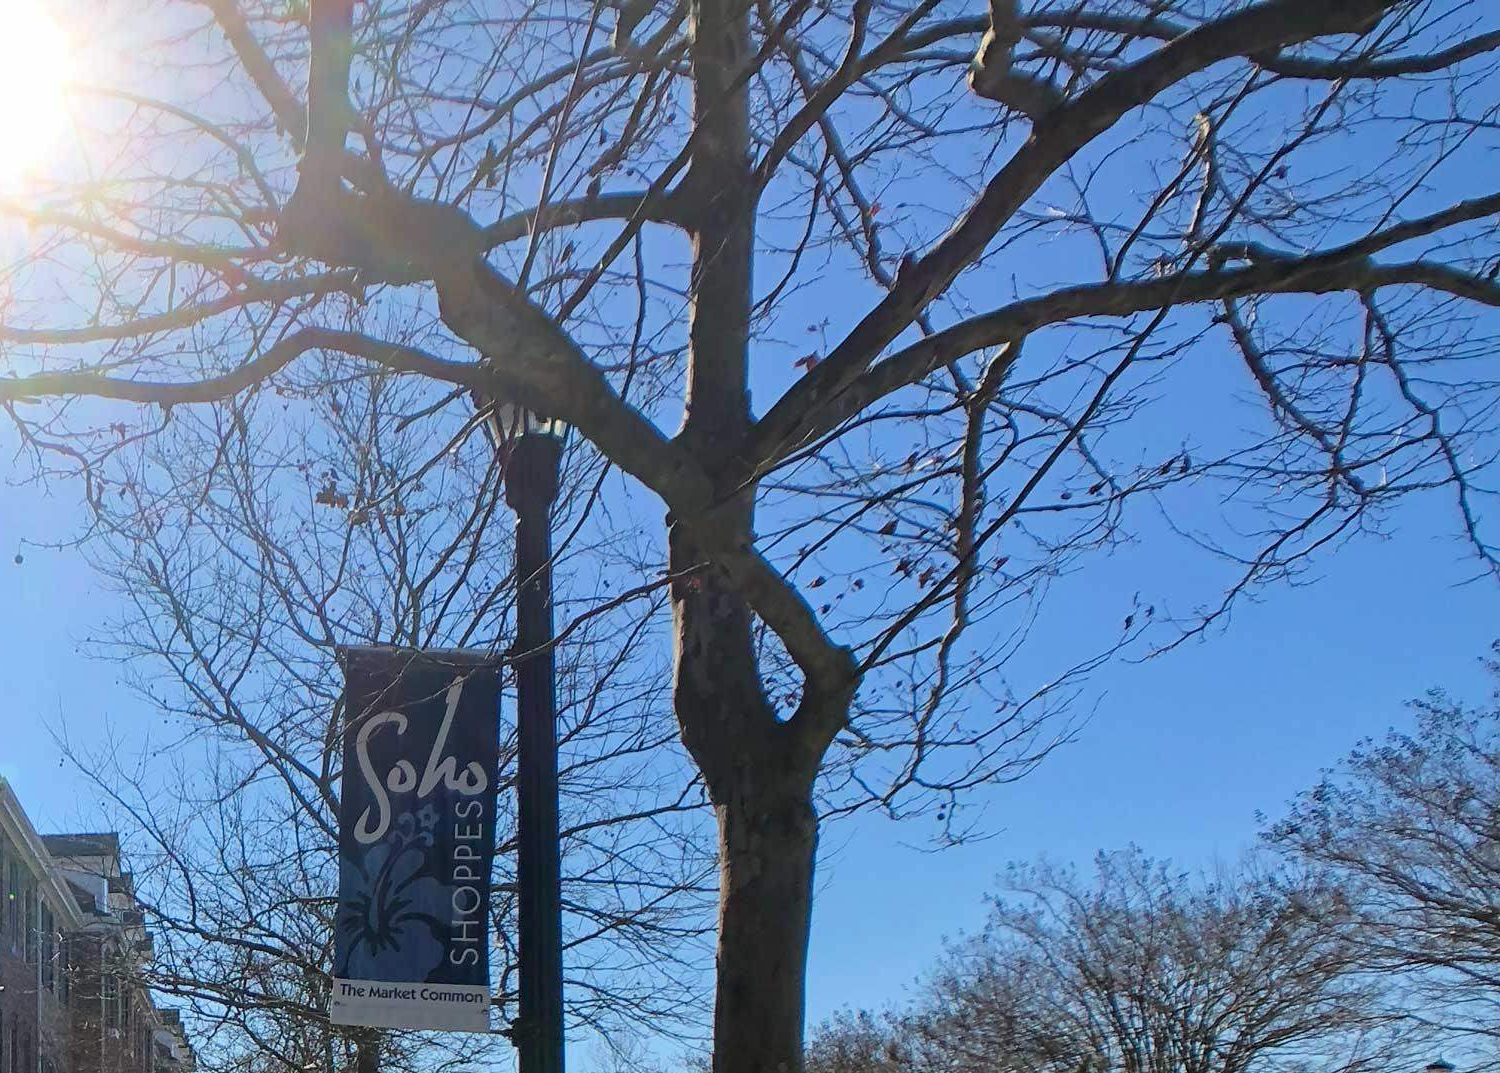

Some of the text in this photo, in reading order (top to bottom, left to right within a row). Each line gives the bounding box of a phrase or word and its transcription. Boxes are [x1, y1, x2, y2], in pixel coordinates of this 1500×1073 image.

[354, 675, 489, 844] Soho
[450, 800, 483, 966] SHOPPES
[340, 983, 484, 1004] The Market Common
